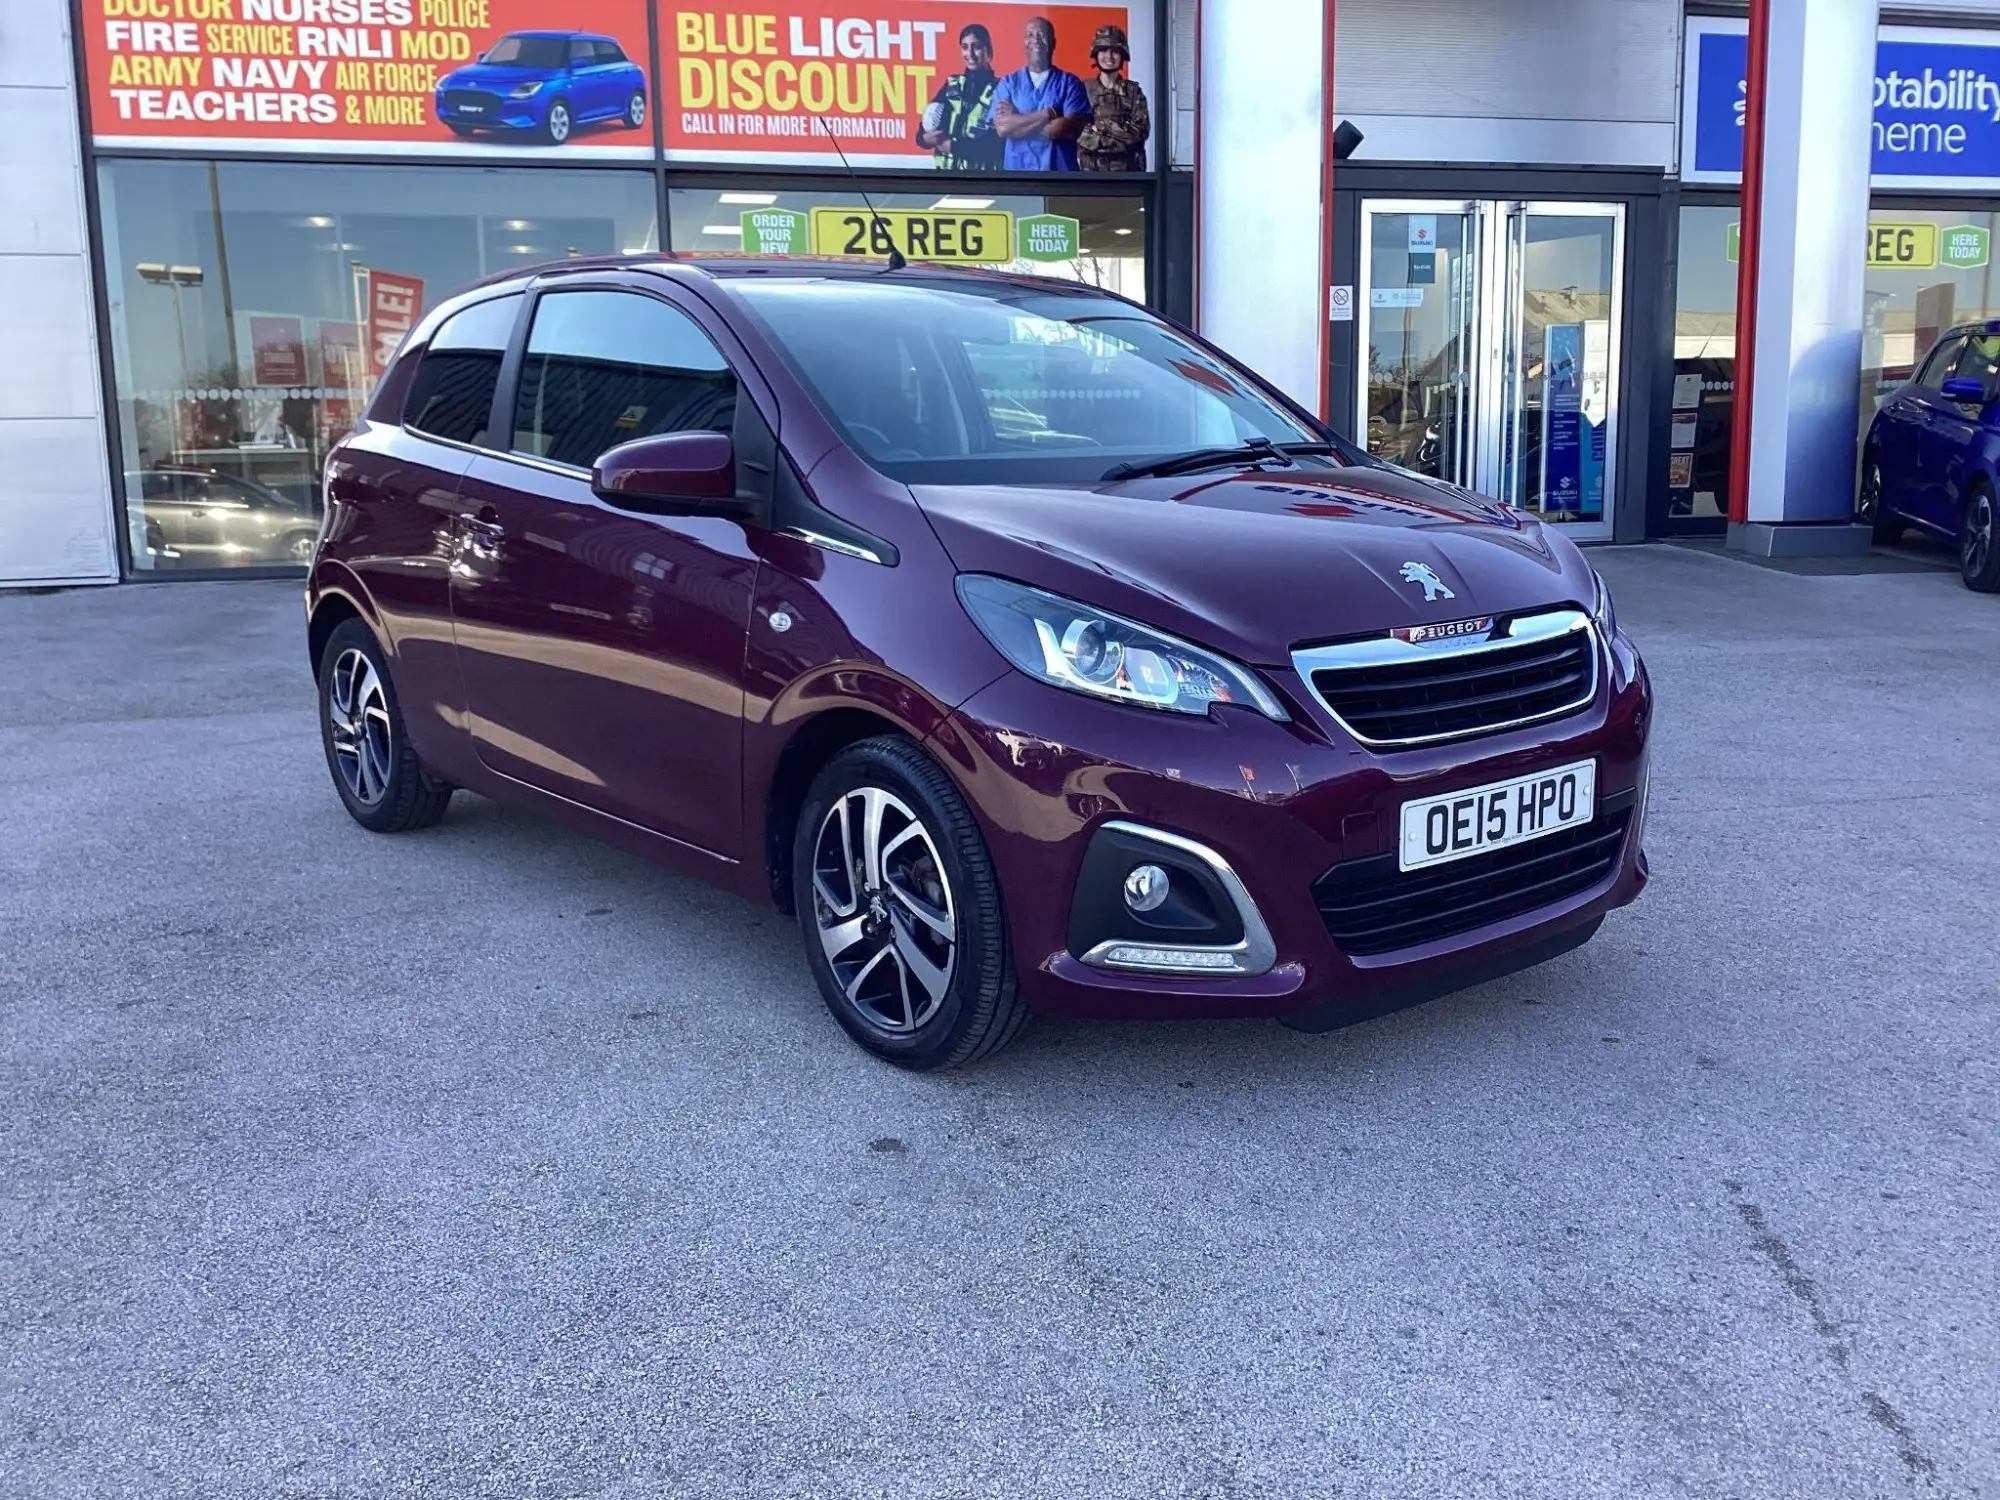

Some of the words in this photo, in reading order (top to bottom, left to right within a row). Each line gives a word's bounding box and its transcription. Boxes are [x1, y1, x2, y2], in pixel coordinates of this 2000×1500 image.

[241, 0, 413, 25] NURSES
[420, 0, 490, 28] POLICE
[105, 20, 200, 53] FIRE
[206, 23, 294, 56] SERVICE
[298, 26, 393, 58] RNLI
[400, 30, 470, 61] MOD
[676, 11, 779, 56] BLUE
[788, 16, 946, 61] LIGHT
[109, 55, 203, 87] ARMY
[212, 57, 328, 90] NAVY
[335, 61, 370, 91] AIR
[374, 63, 437, 93] FORCE
[678, 57, 936, 115] DISCOUNT
[110, 89, 338, 125] TEACHERS
[345, 95, 361, 124] &
[365, 96, 427, 126] MORE
[681, 113, 716, 135] CALL
[718, 114, 735, 135] IN
[737, 115, 764, 136] FOR
[766, 115, 806, 137] MORE
[810, 116, 906, 139] INFORMATION
[752, 213, 795, 229] ORDER
[1031, 223, 1066, 239] HERE
[757, 228, 791, 242] YOUR
[759, 241, 791, 254] NEW
[843, 215, 893, 255] 26
[907, 217, 983, 257] REG
[1027, 238, 1069, 253] TODAY
[1867, 228, 1915, 262] EG
[1951, 233, 1980, 246] HERE
[1949, 246, 1981, 259] TODAY
[1417, 620, 1482, 641] PEUGEOT
[1426, 790, 1508, 856] OE15
[1517, 773, 1576, 834] HPO
